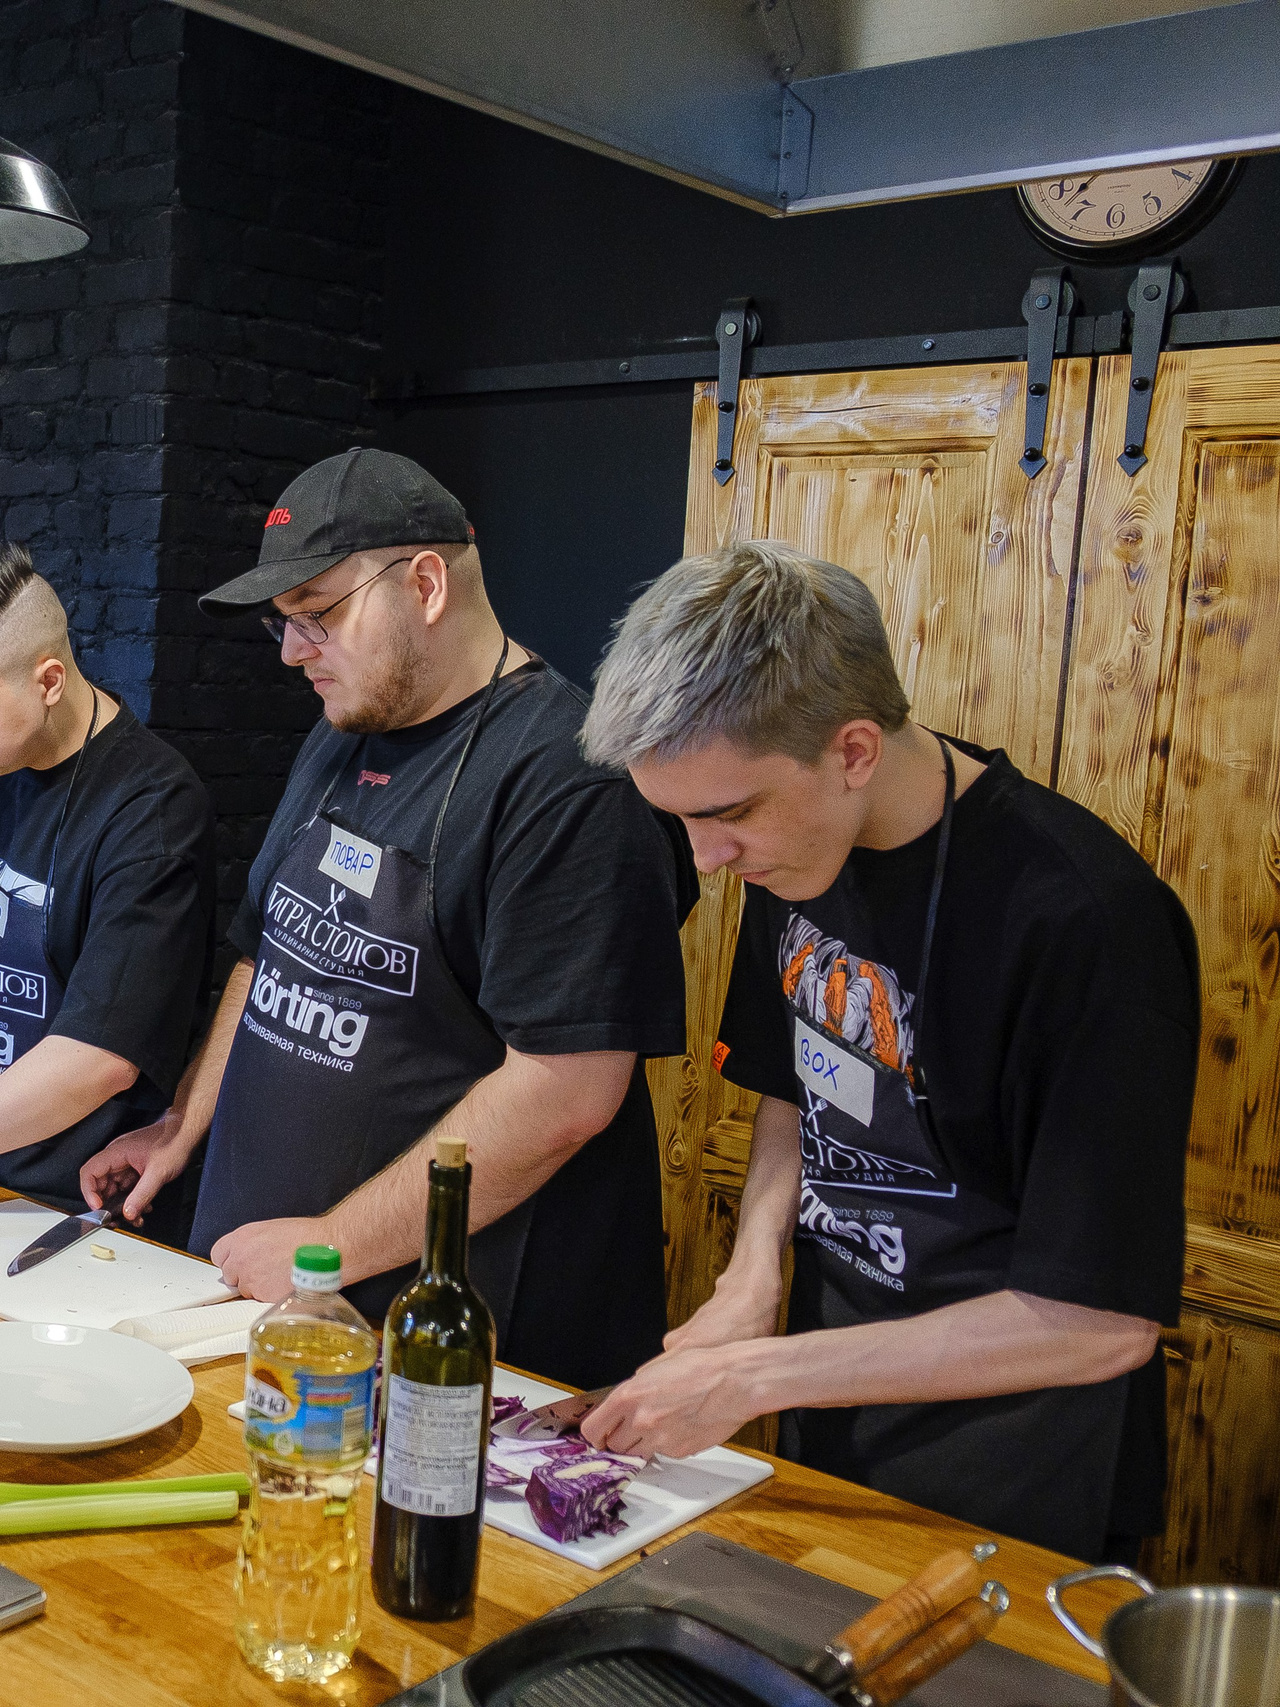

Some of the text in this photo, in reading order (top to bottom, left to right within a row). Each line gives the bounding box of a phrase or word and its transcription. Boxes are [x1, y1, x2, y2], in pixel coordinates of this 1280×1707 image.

[1070, 199, 1097, 222] 7
[1106, 203, 1126, 229] 6
[1142, 191, 1162, 216] 5
[267, 890, 407, 975] ИГРА СТОЛОВ
[318, 956, 365, 978] СТУДИЯ
[251, 959, 370, 1057] körting
[313, 988, 362, 1010] since 1889
[297, 1045, 354, 1072] техника
[854, 1254, 906, 1293] техника
